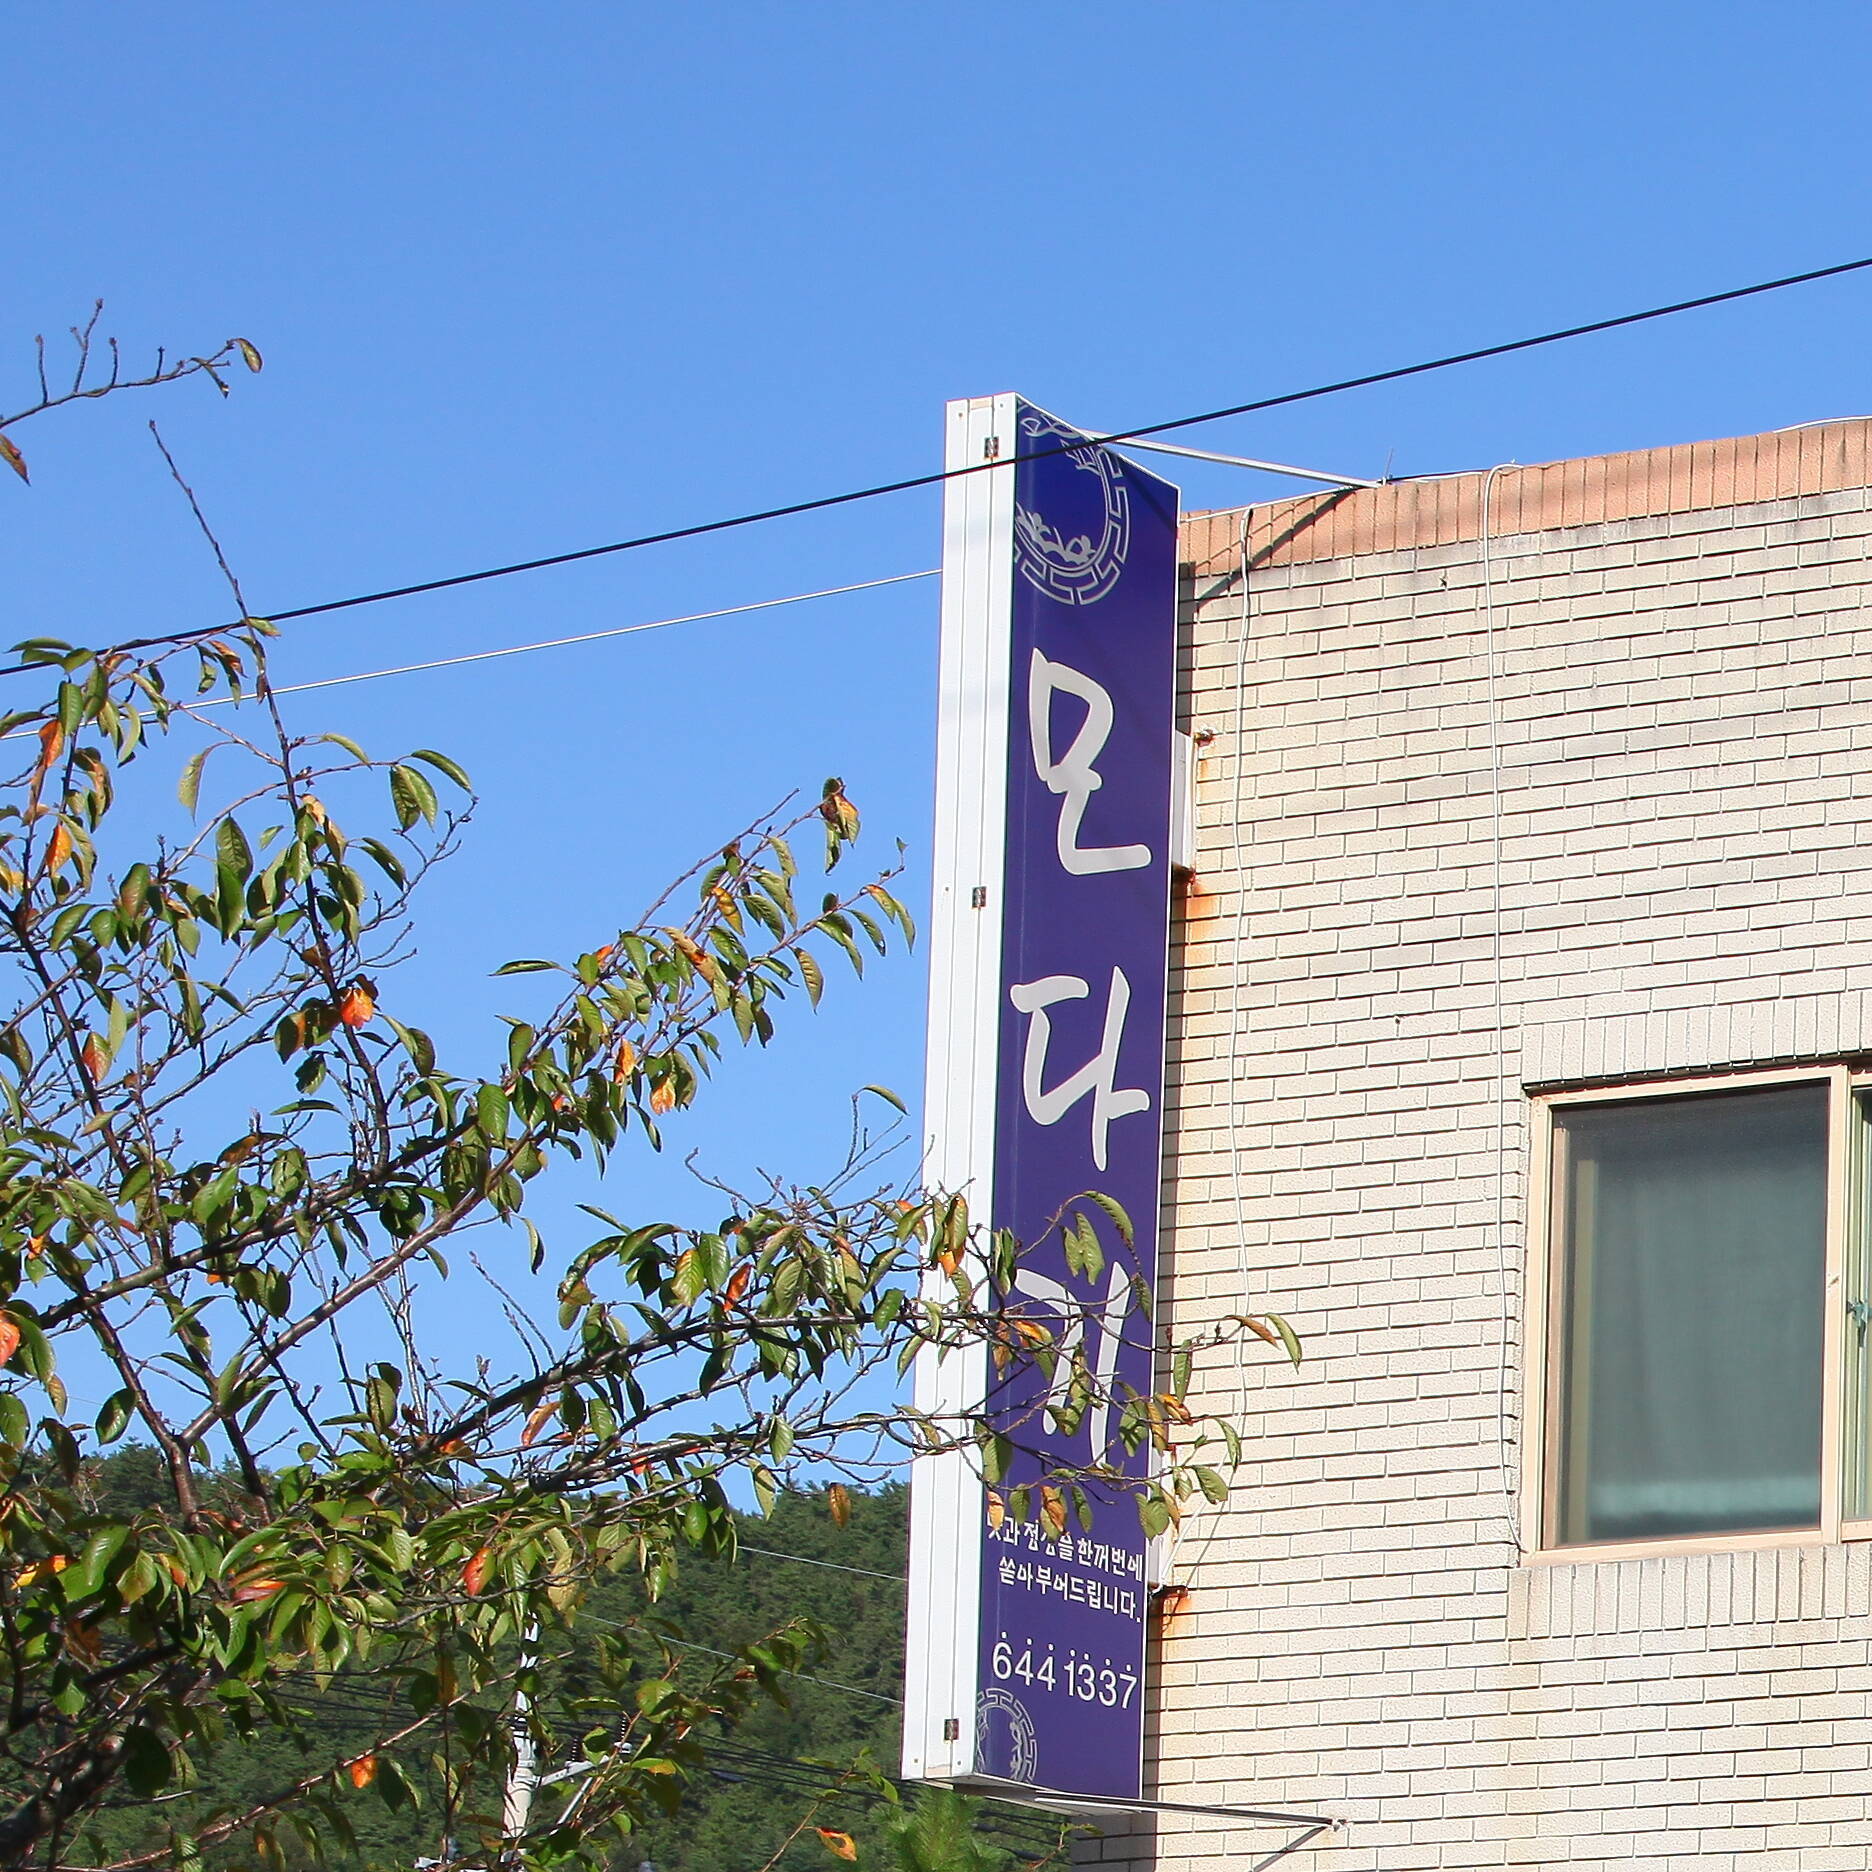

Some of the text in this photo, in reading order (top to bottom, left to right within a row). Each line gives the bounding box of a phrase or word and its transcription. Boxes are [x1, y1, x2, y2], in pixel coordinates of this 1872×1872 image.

[1077, 1537, 1143, 1582] 한꺼번에
[992, 1640, 1137, 1709] 644 1337
